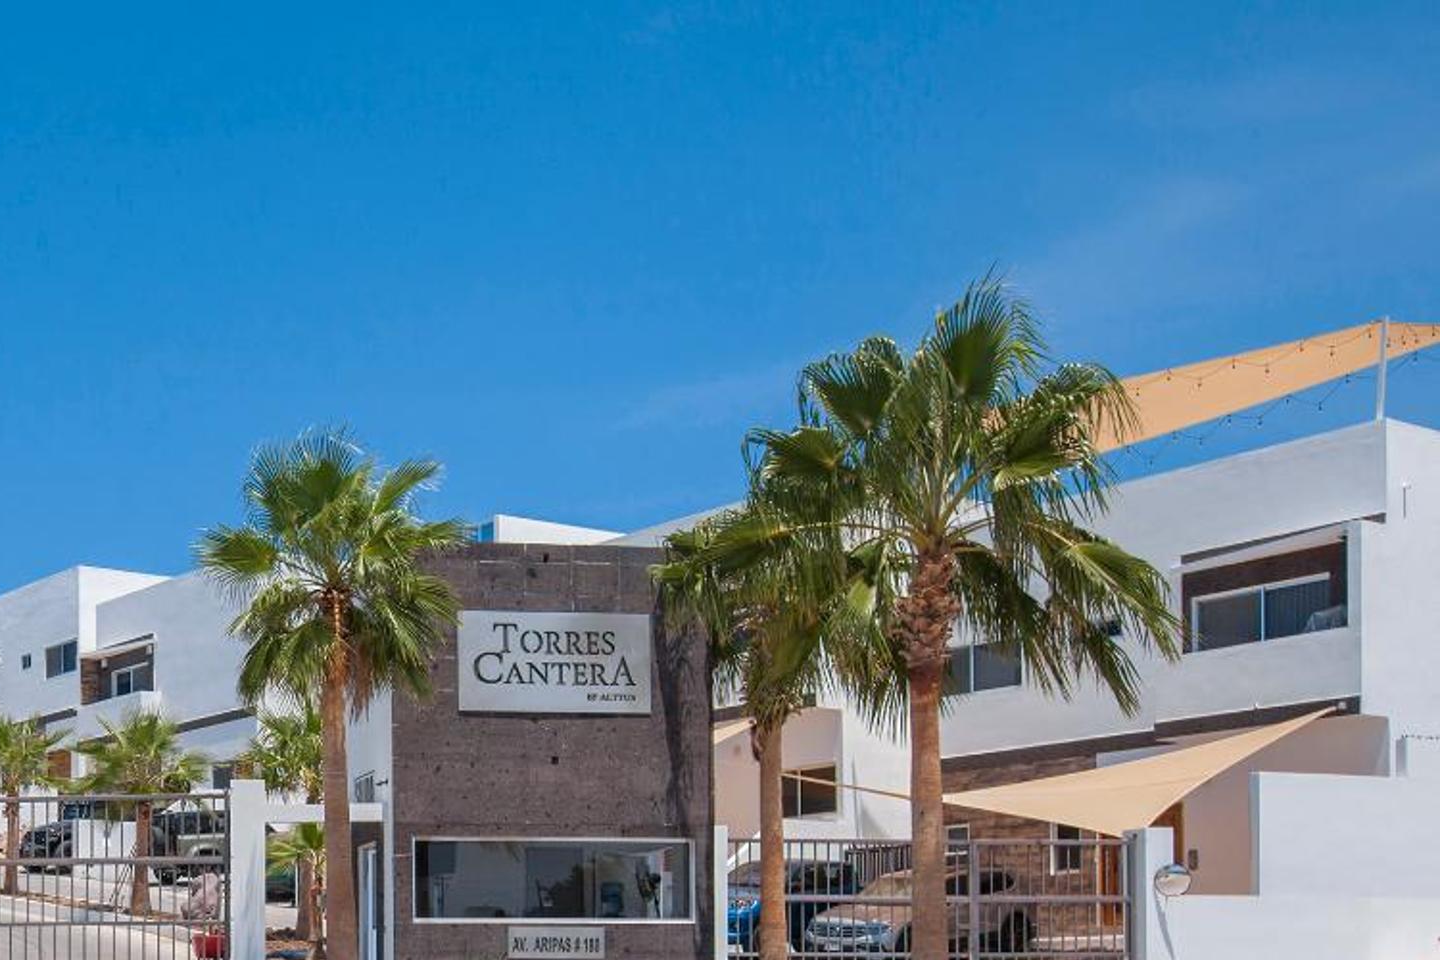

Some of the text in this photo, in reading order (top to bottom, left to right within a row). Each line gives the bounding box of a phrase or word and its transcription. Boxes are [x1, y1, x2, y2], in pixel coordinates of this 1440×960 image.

[492, 623, 616, 656] TORRES
[473, 651, 637, 687] CANTERA
[512, 936, 529, 953] AV.
[534, 936, 572, 953] ARIPAS
